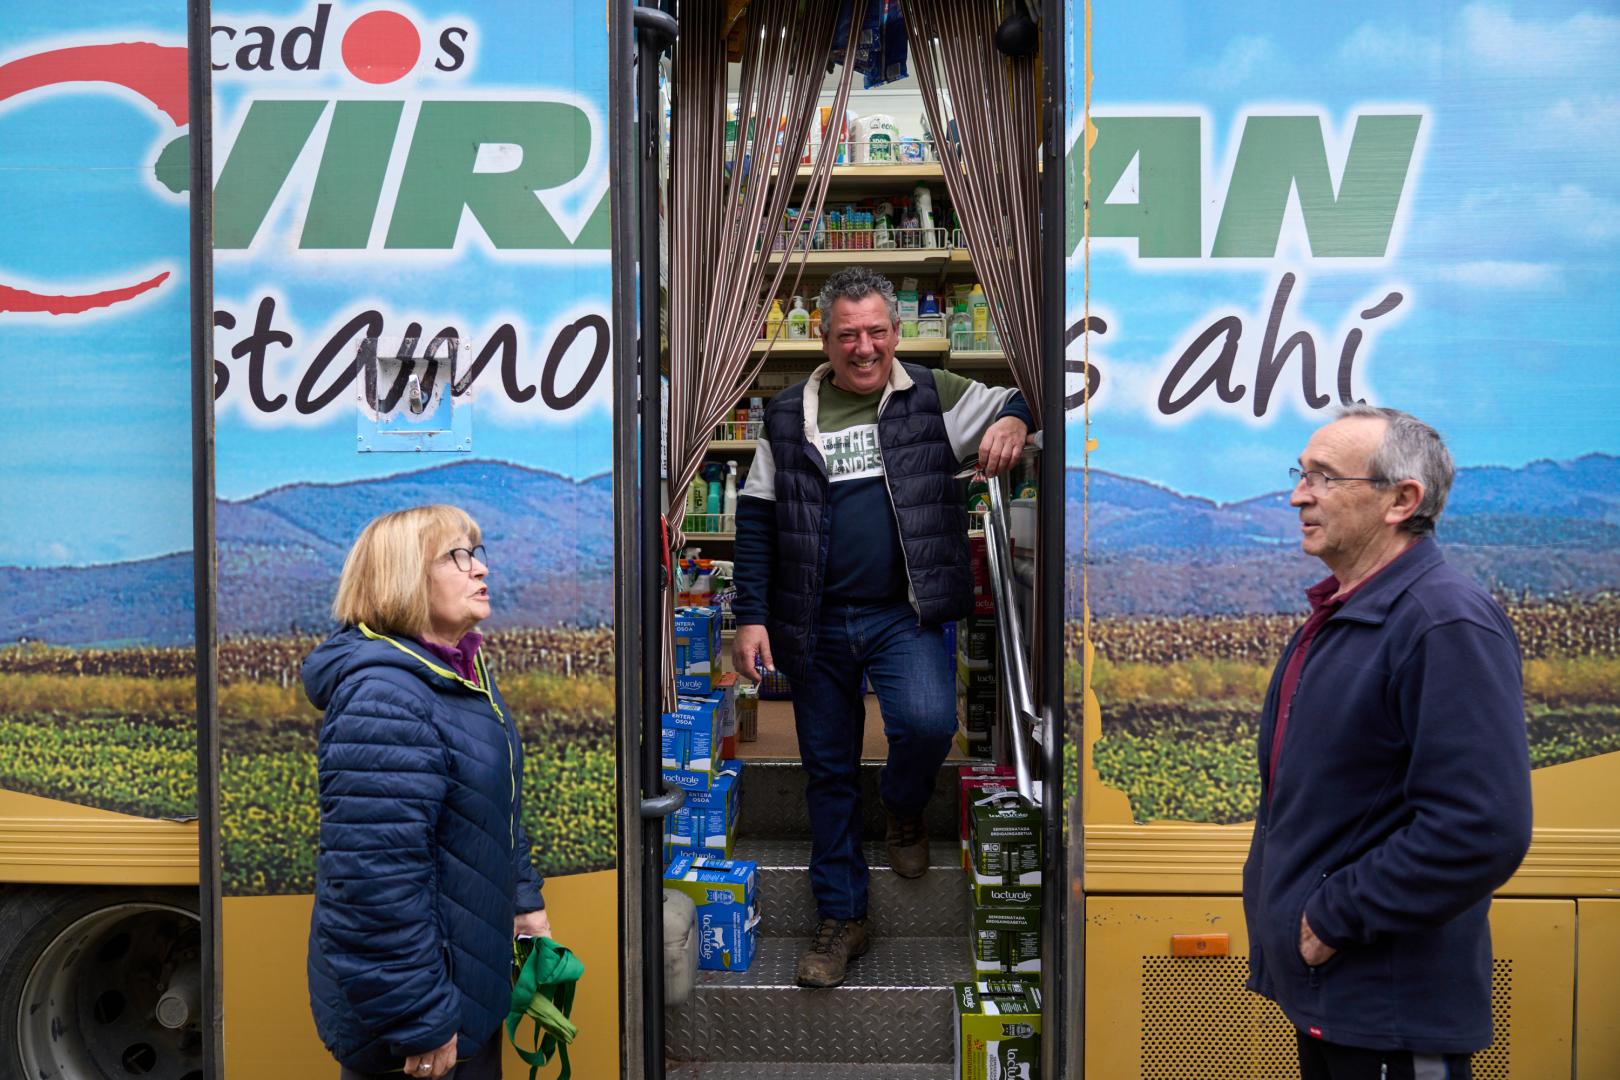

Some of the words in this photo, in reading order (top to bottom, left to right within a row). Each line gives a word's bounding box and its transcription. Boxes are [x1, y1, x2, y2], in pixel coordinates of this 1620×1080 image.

[1158, 272, 1404, 417] ahí
[672, 713, 696, 721] ENTERA
[675, 718, 693, 726] OSOA
[663, 773, 699, 785] lacturale
[991, 890, 1033, 903] lacturale
[701, 914, 714, 960] lacturale
[1007, 1048, 1019, 1080] lactu
